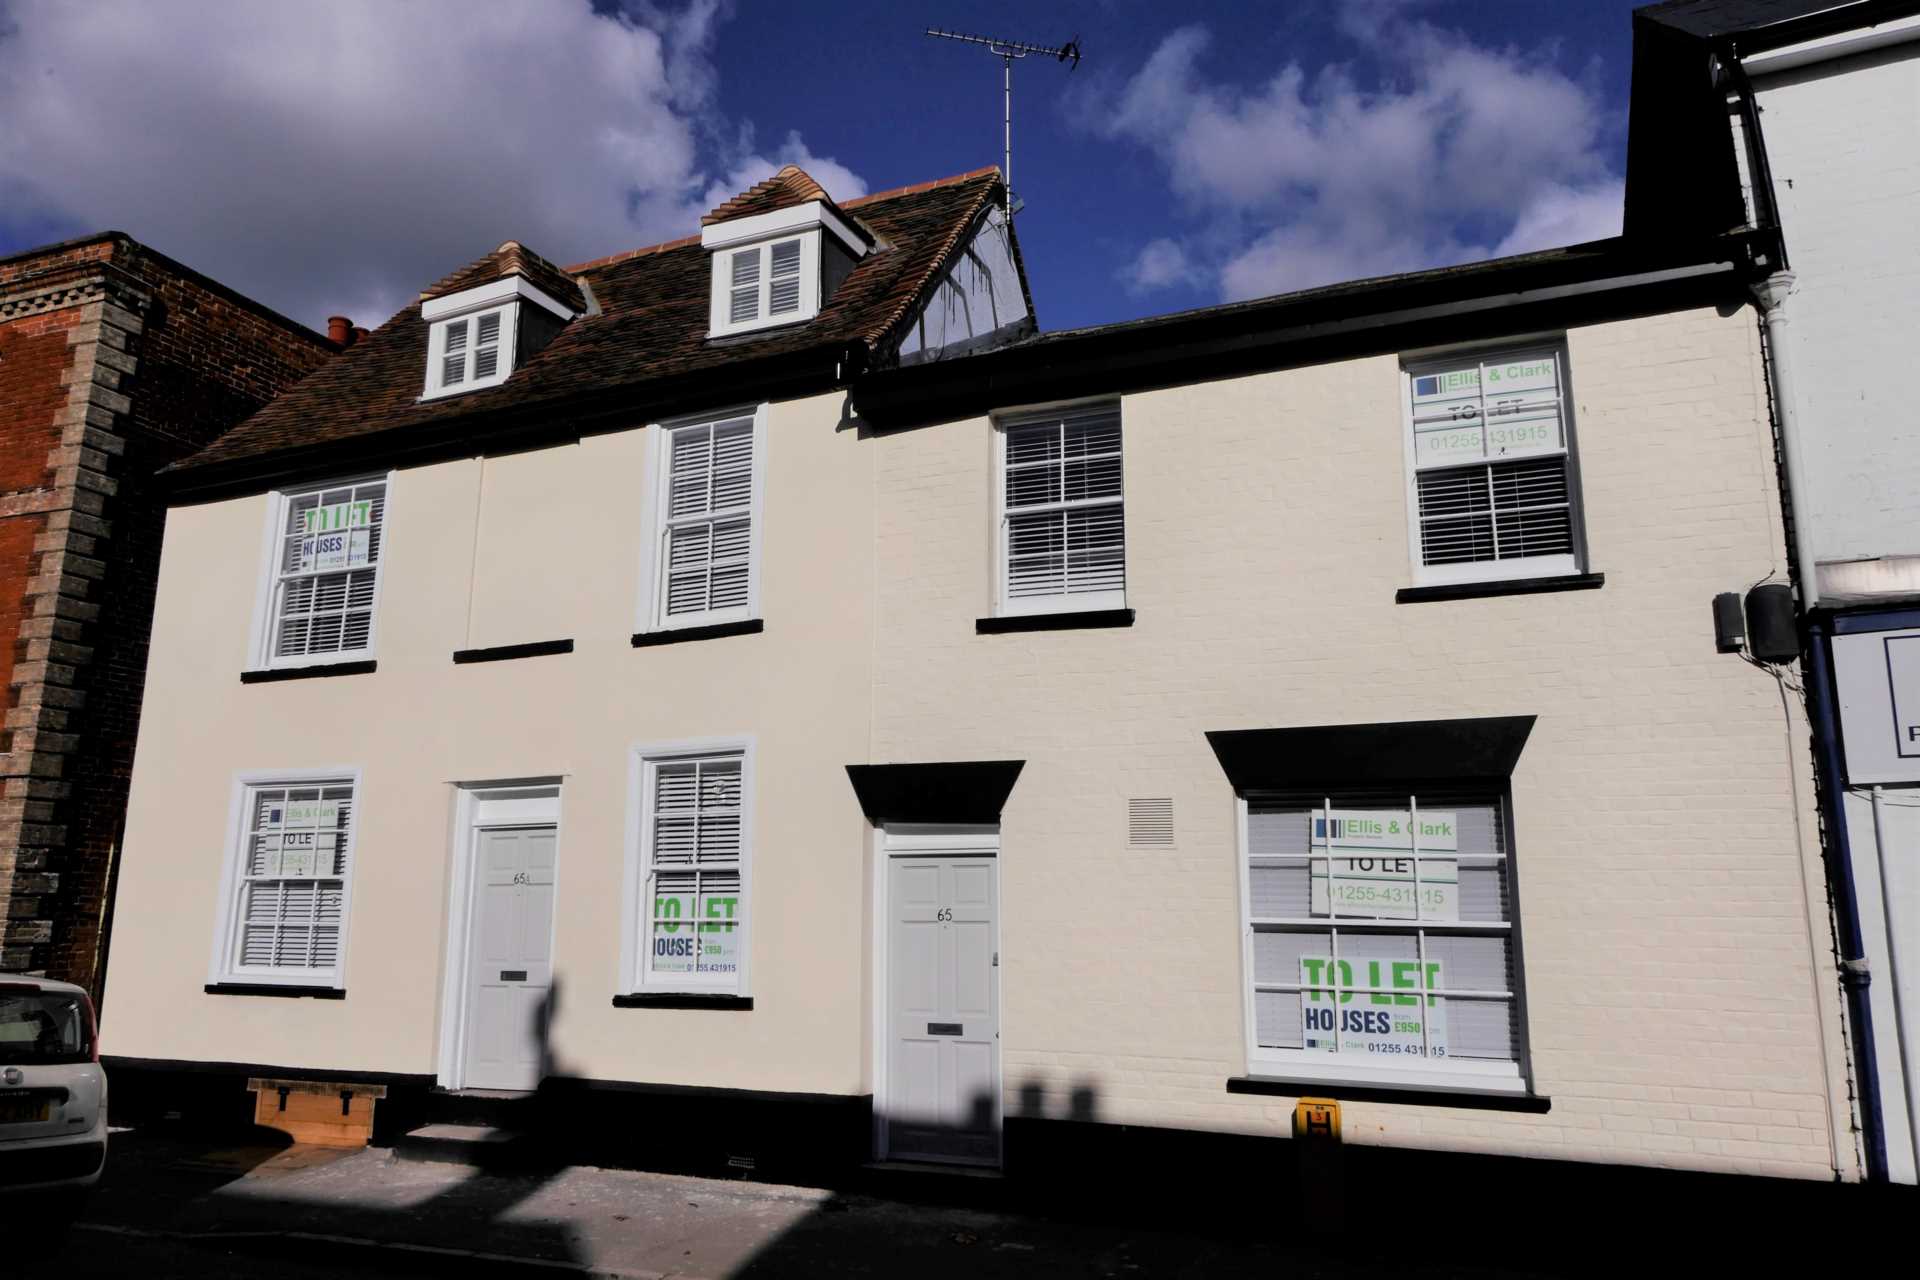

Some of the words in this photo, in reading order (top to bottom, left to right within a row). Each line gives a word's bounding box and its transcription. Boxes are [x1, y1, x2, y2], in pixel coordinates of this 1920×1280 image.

[1450, 371, 1481, 388] Ellis
[1489, 368, 1501, 381] &
[1506, 362, 1552, 380] Clark
[1448, 404, 1477, 421] TO
[1485, 398, 1524, 417] ET
[1347, 819, 1383, 835] Ellis
[1388, 820, 1400, 835] &
[299, 833, 314, 845] LE
[1382, 857, 1421, 874] LE
[937, 908, 953, 922] 65
[653, 938, 703, 956] OUSES
[1302, 959, 1353, 1004] TO
[1368, 961, 1440, 1008] LET
[1305, 1007, 1391, 1034] HOUSES
[1368, 1042, 1401, 1054] 01255
[1404, 1044, 1446, 1057] 43115
